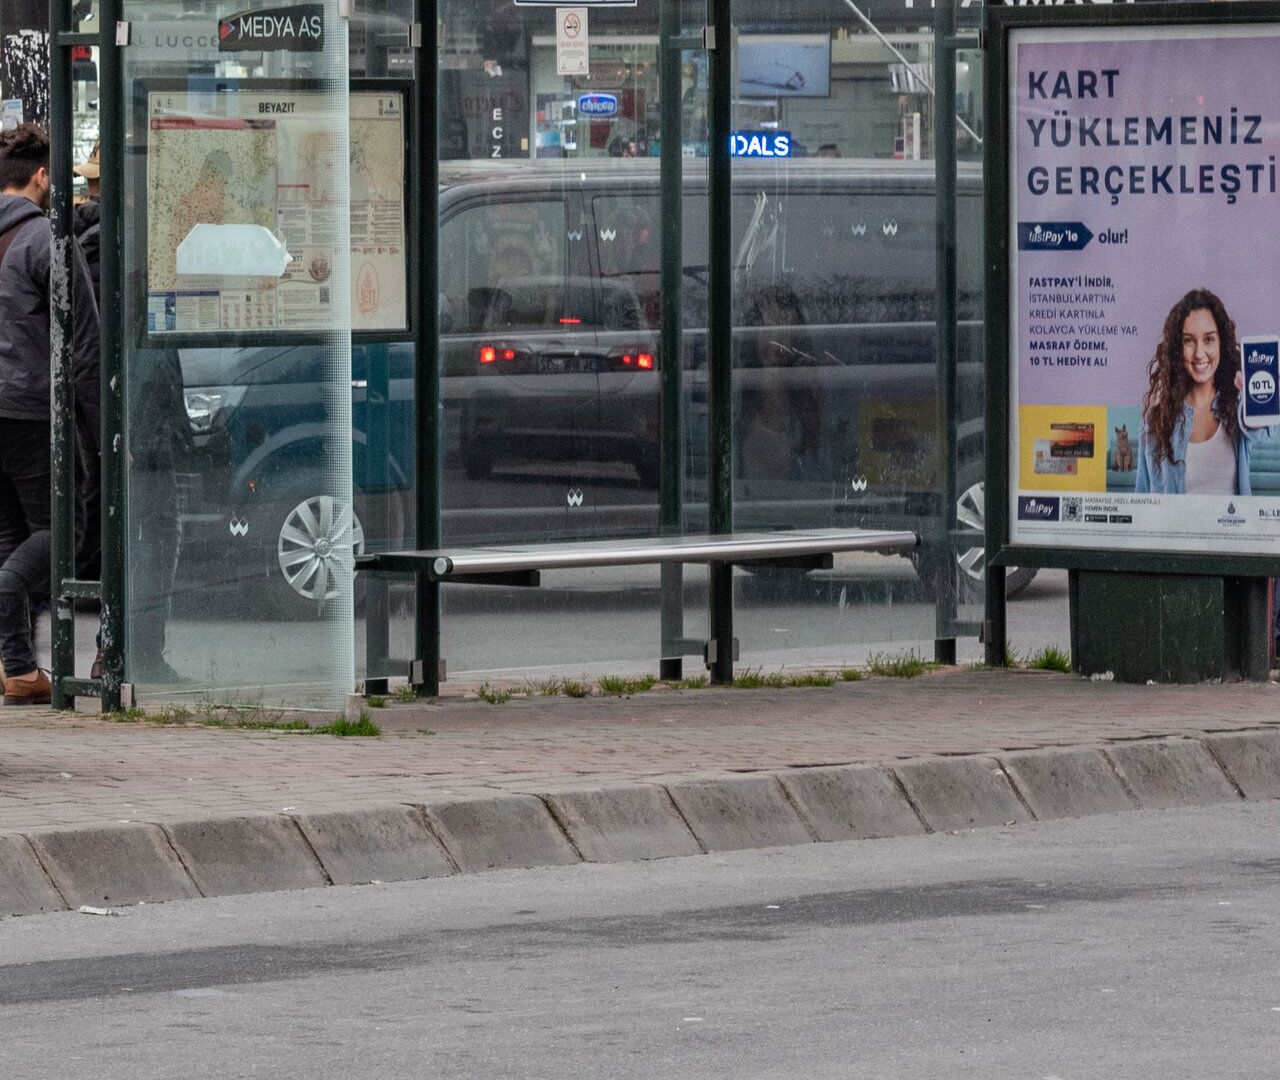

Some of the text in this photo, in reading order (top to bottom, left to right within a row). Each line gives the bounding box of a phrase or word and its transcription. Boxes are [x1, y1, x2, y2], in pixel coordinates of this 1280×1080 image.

[239, 16, 322, 40] MEDYA AŞ
[1028, 69, 1120, 99] KART
[259, 102, 295, 113] BEYAZIT
[1027, 107, 1263, 148] YÜKLEMENİZ
[1027, 155, 1276, 205] GERÇEKLEŞTİ
[1098, 228, 1128, 245] olur!
[1029, 308, 1057, 319] KREDİ
[1029, 324, 1075, 335] KOLAYCA
[1078, 324, 1118, 335] YÜKLEME
[1029, 340, 1071, 351] MASRAF
[1030, 357, 1040, 366] 10
[1042, 357, 1054, 367] TL
[1056, 355, 1092, 367] HEDİYE
[1251, 380, 1272, 390] 10 TL
